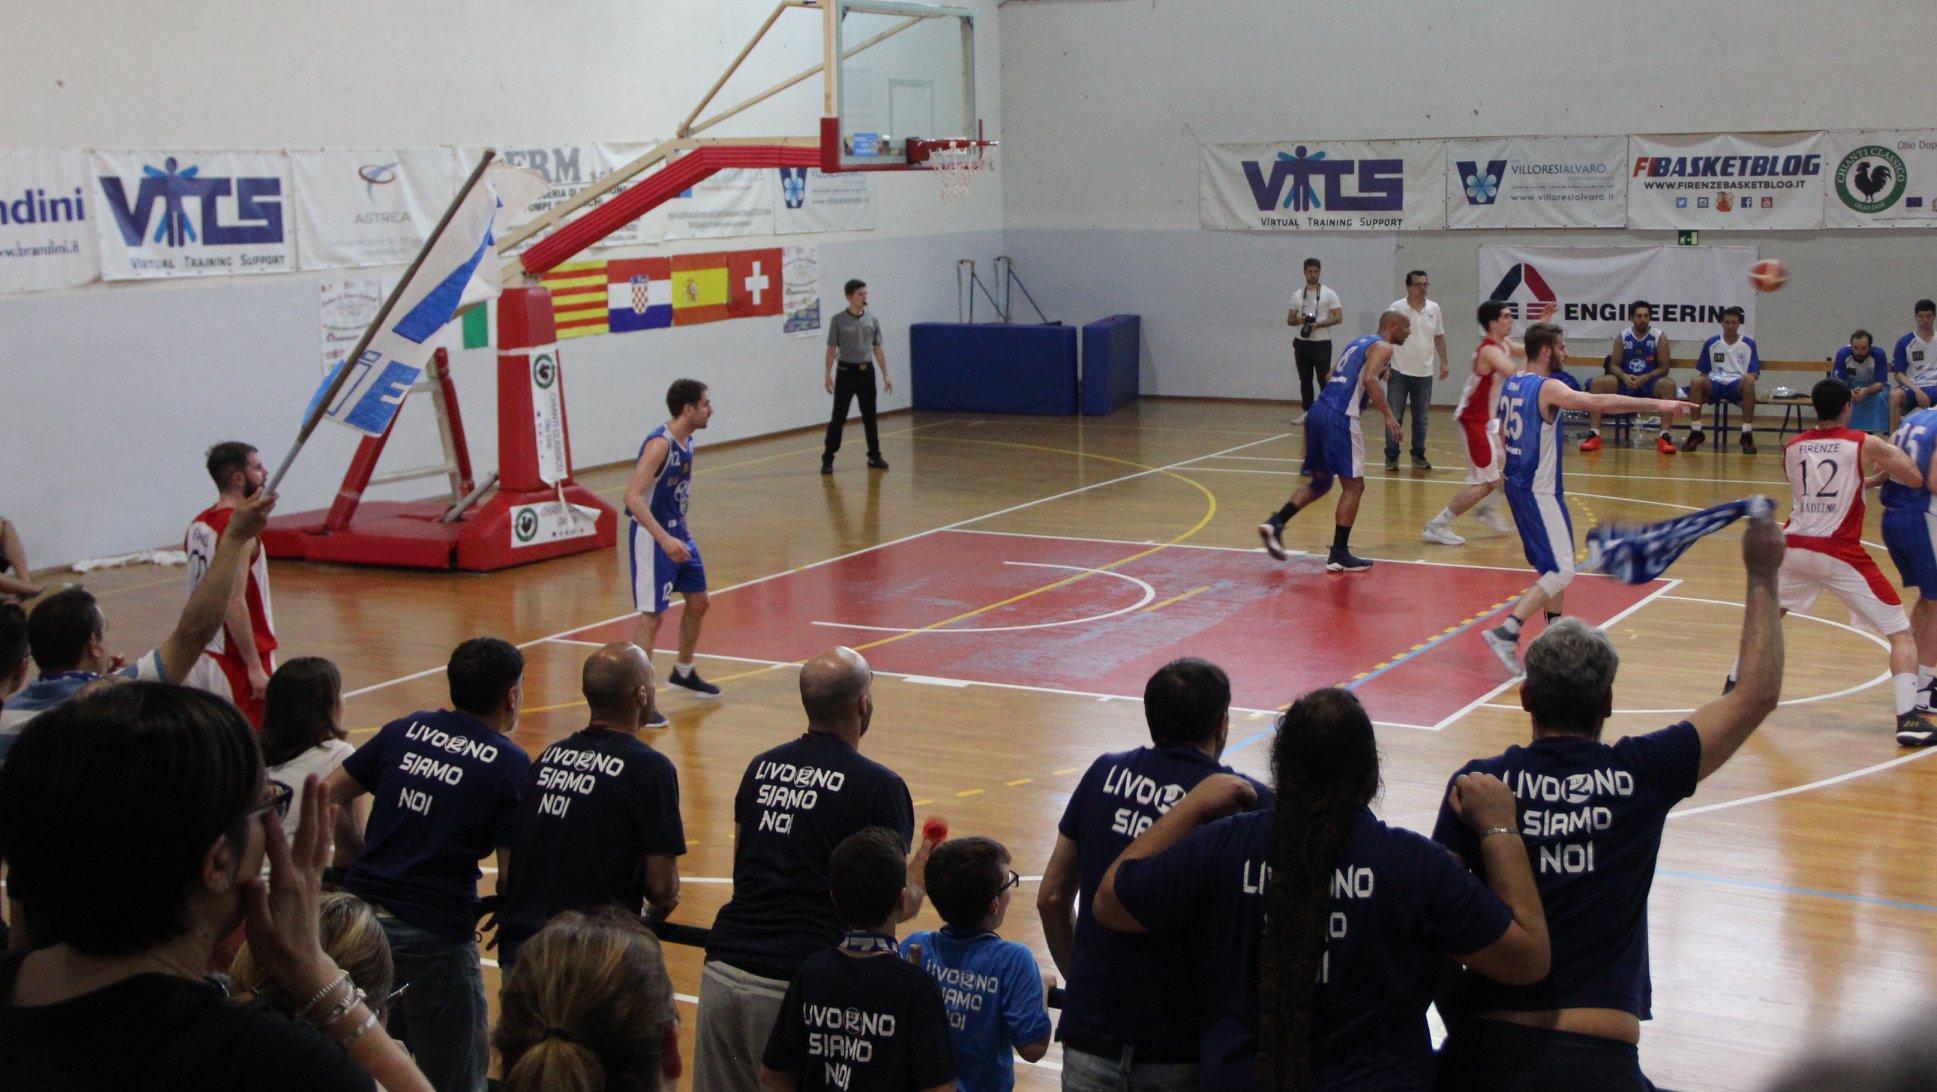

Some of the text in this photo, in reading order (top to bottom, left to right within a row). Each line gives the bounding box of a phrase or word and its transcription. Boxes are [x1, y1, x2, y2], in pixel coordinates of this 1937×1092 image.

[1643, 180, 1807, 190] WWW.FIRENZEBASKETBLOG.IT
[1260, 216, 1403, 227] VIRTUAL TRAINING SUPPORT
[184, 255, 232, 268] TRAINING
[241, 253, 285, 267] SUPPORT
[1500, 395, 1524, 440] 25
[1799, 442, 1840, 454] FIRENZE
[1799, 458, 1839, 498] 12
[398, 751, 464, 786] SIAMO
[536, 766, 596, 796] SIAMO
[397, 786, 433, 816] NOI
[756, 784, 818, 811] SIAMO
[1102, 764, 1187, 815] LIVOR
[537, 792, 571, 820] NOI
[1522, 805, 1613, 837] SIAMO
[758, 809, 795, 836] NOI
[1111, 807, 1153, 839] SIA
[1540, 840, 1595, 874] NOI
[941, 986, 983, 1012] AMO
[946, 1009, 966, 1033] OI
[808, 1032, 873, 1063] SIAMO
[824, 1061, 852, 1092] NOI
